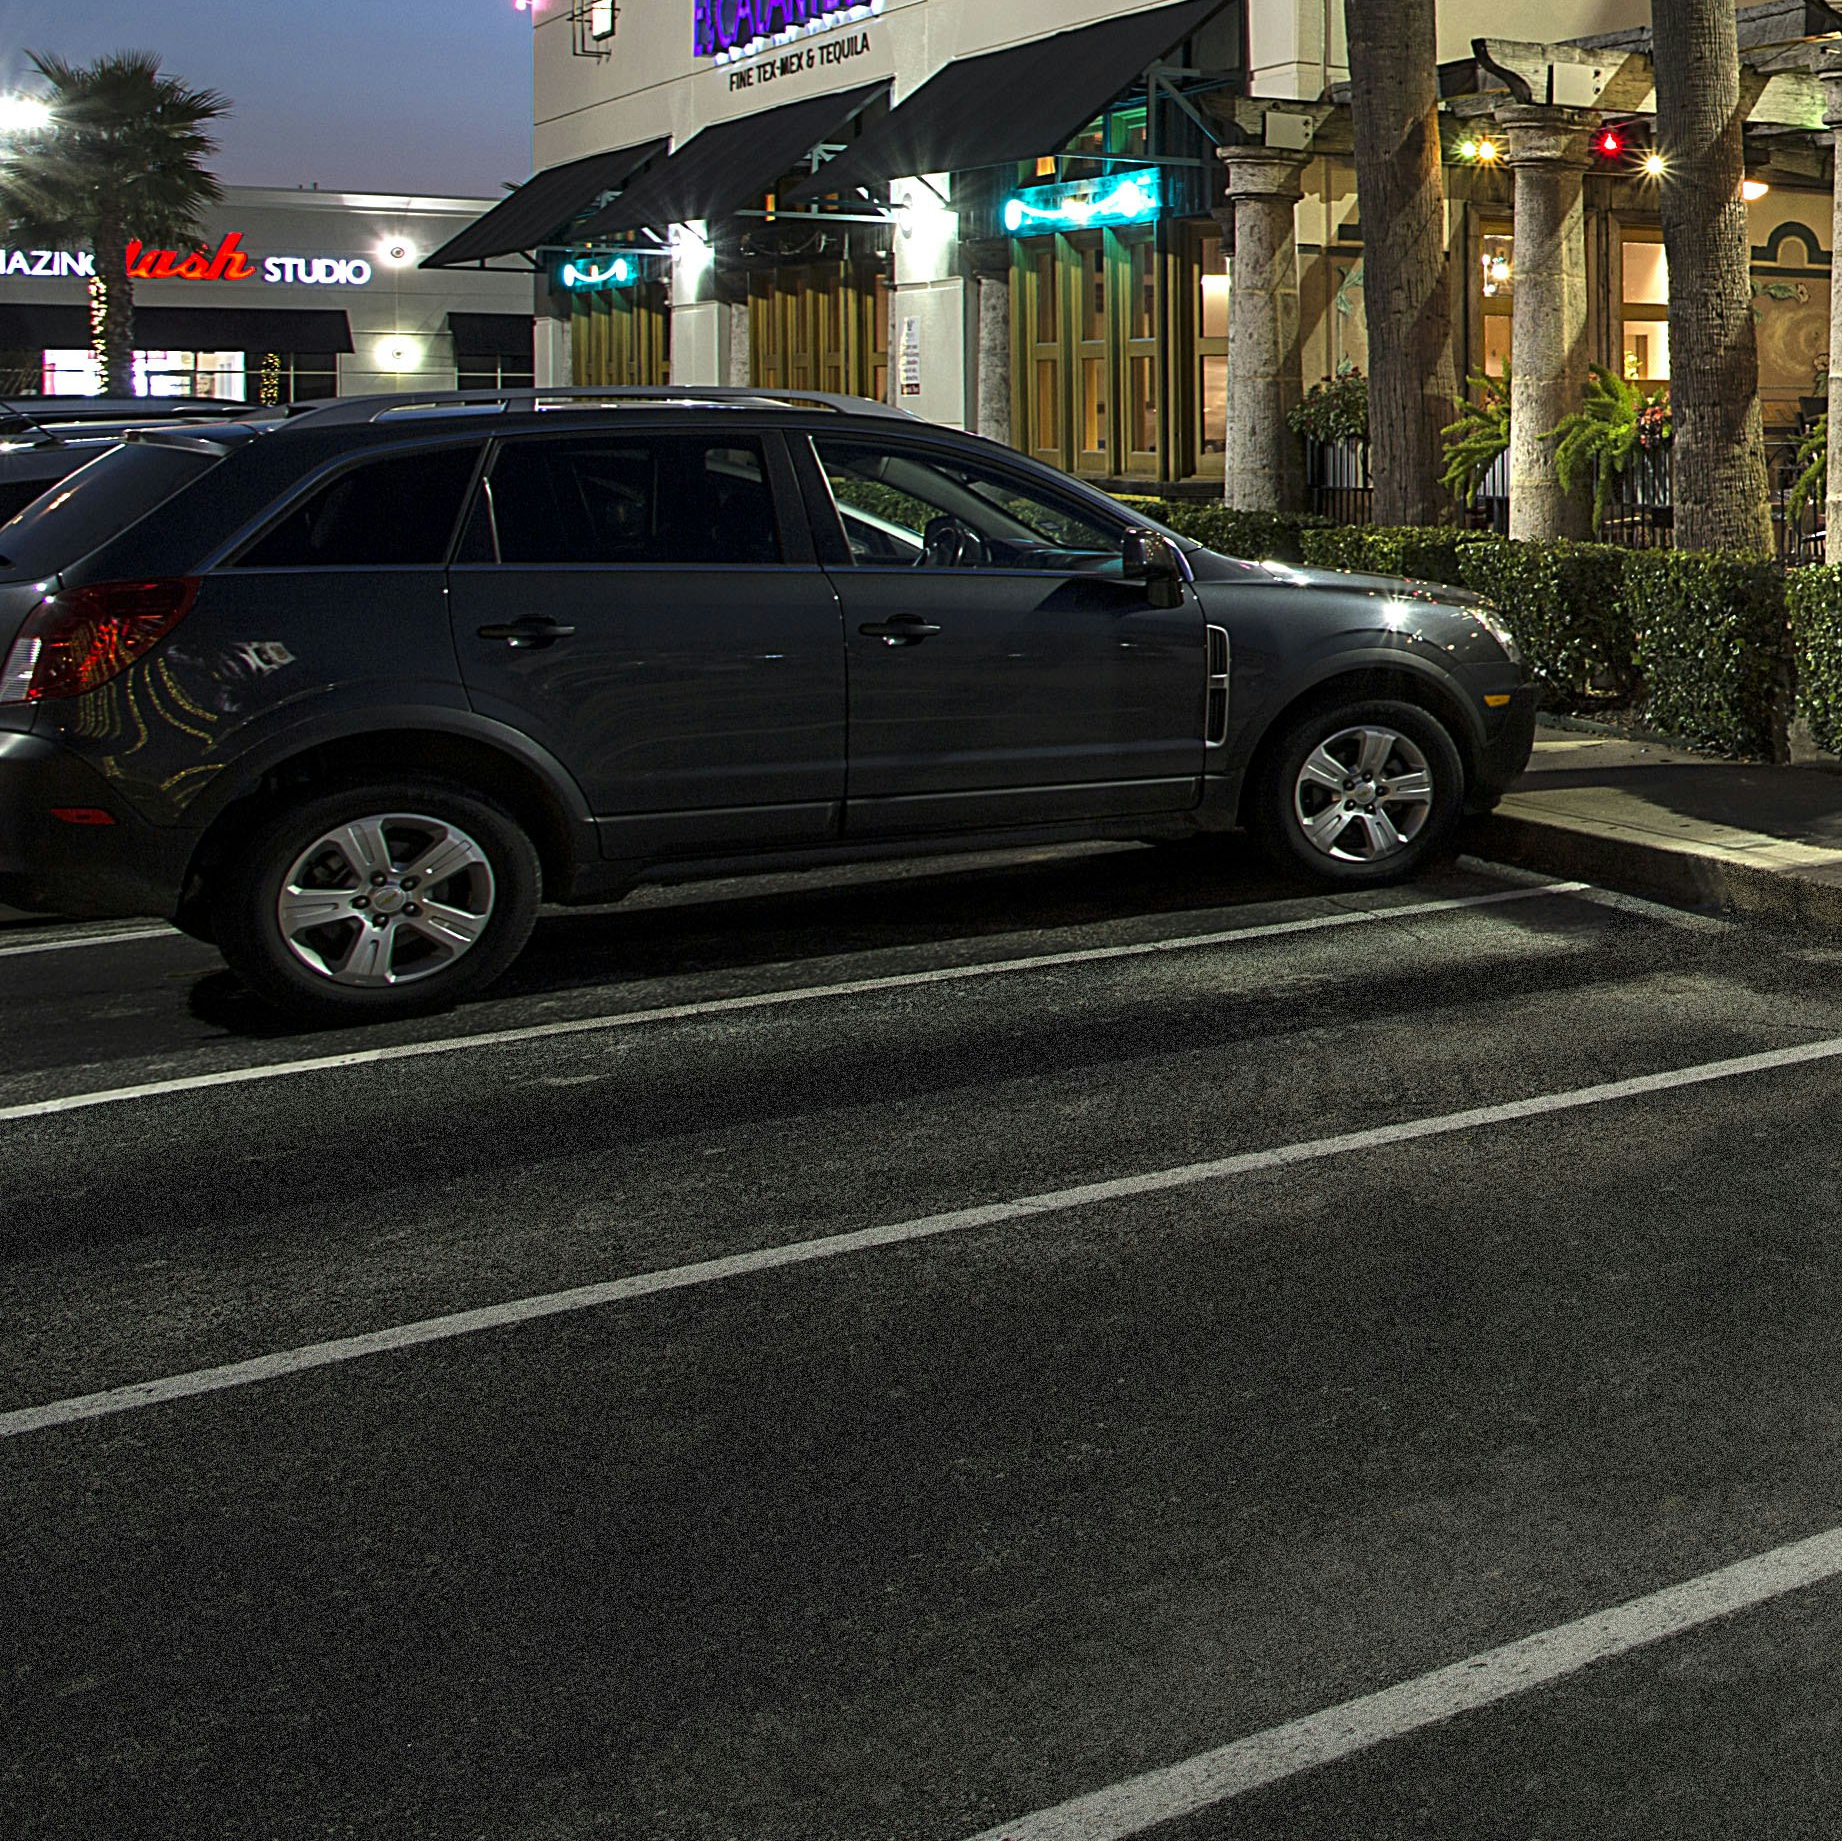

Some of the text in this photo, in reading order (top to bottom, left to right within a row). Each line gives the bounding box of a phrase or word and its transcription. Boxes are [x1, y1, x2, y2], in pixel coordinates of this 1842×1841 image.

[729, 31, 871, 92] FINE TEX-MEX & TEQUILA
[264, 256, 372, 284] STUDIO
